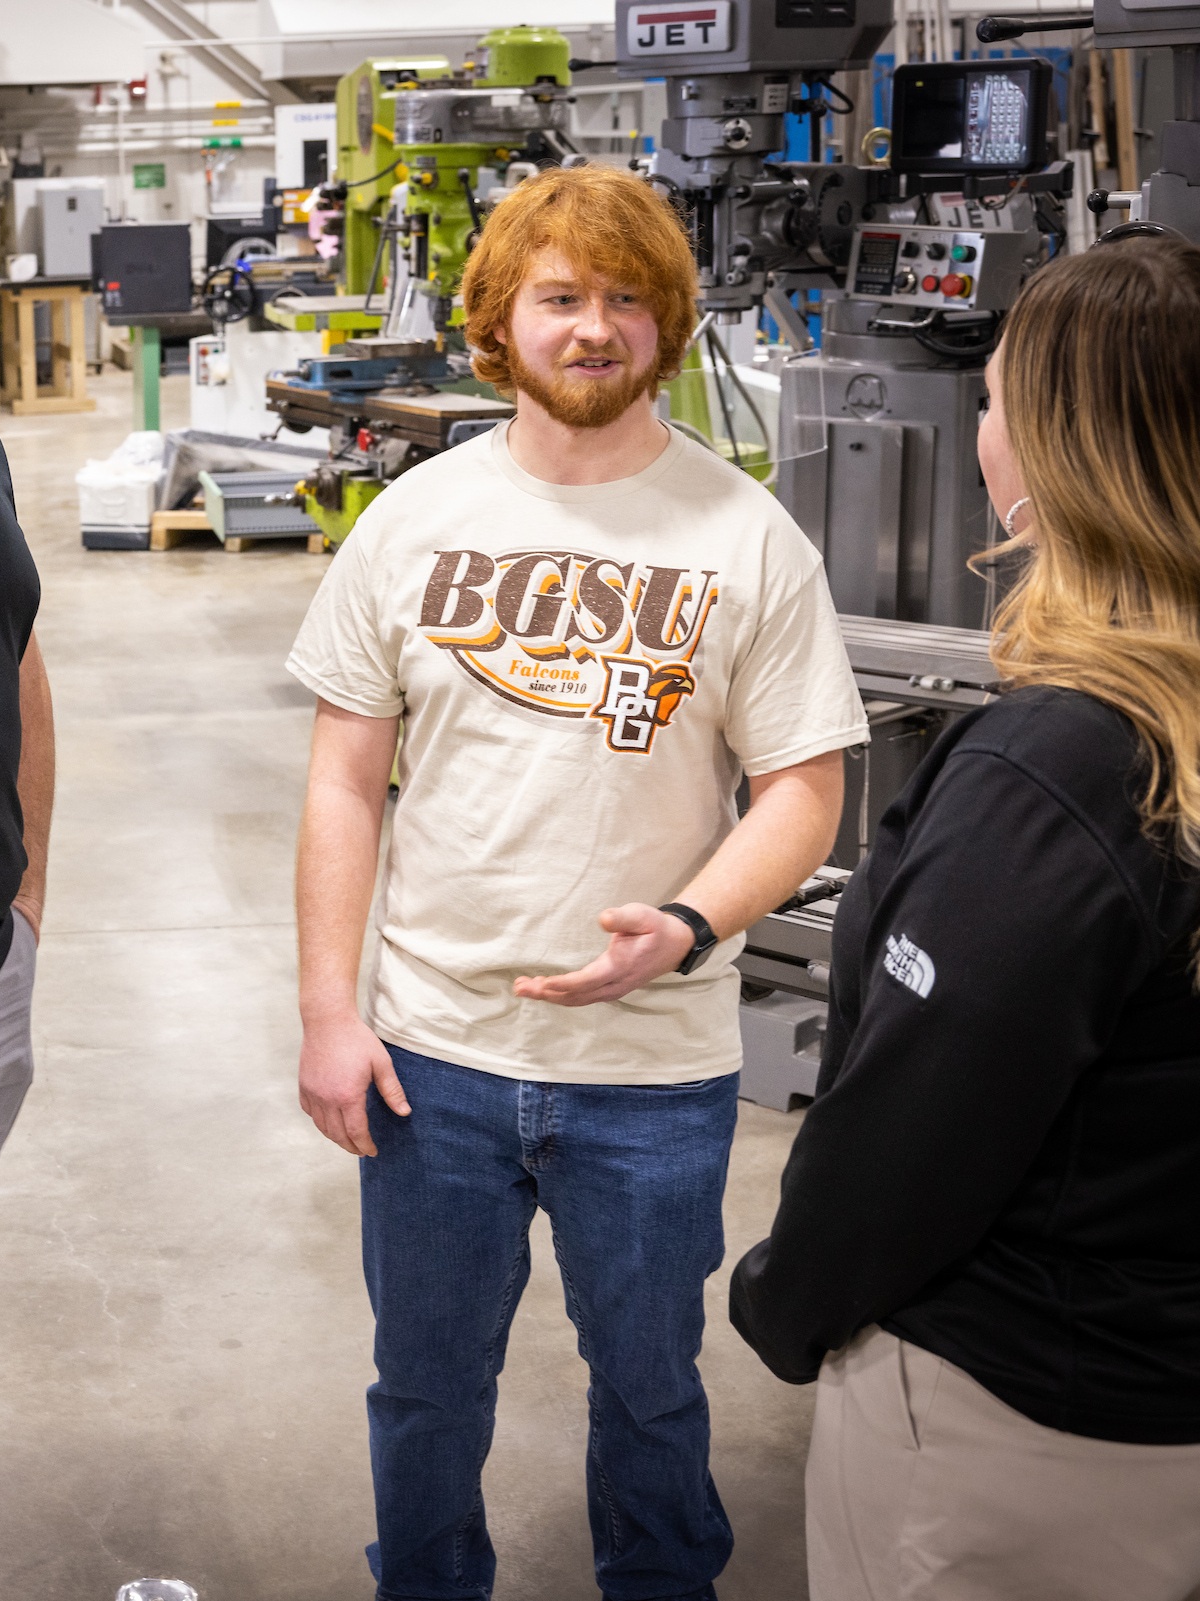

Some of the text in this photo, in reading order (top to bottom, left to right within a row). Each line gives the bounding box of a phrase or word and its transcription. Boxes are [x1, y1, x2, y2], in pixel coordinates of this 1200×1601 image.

[637, 22, 716, 48] JET
[417, 549, 718, 652] BGSU
[508, 659, 580, 682] Falcons
[528, 679, 587, 695] since 1910
